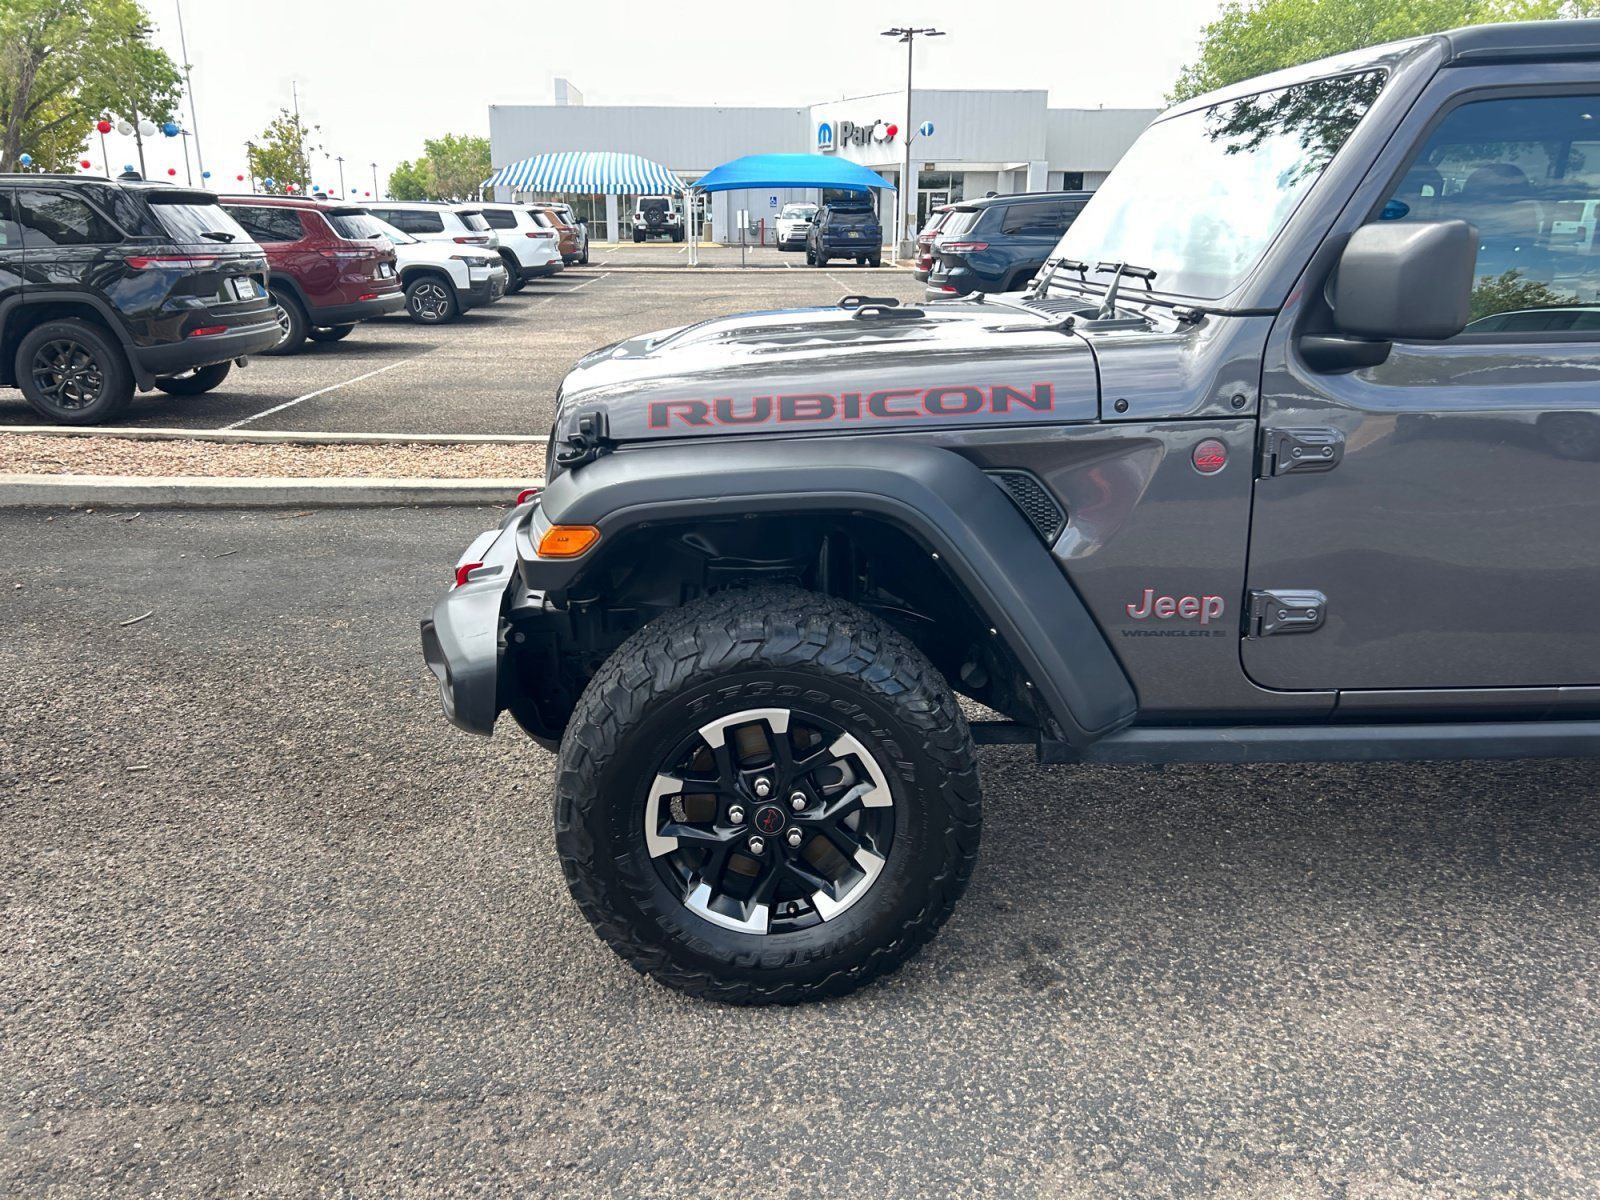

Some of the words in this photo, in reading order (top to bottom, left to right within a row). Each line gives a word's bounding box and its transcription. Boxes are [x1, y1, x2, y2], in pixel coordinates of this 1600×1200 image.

[648, 383, 1057, 430] RUBICON
[1126, 588, 1225, 624] Jeep
[1122, 629, 1210, 638] WRANGLER
